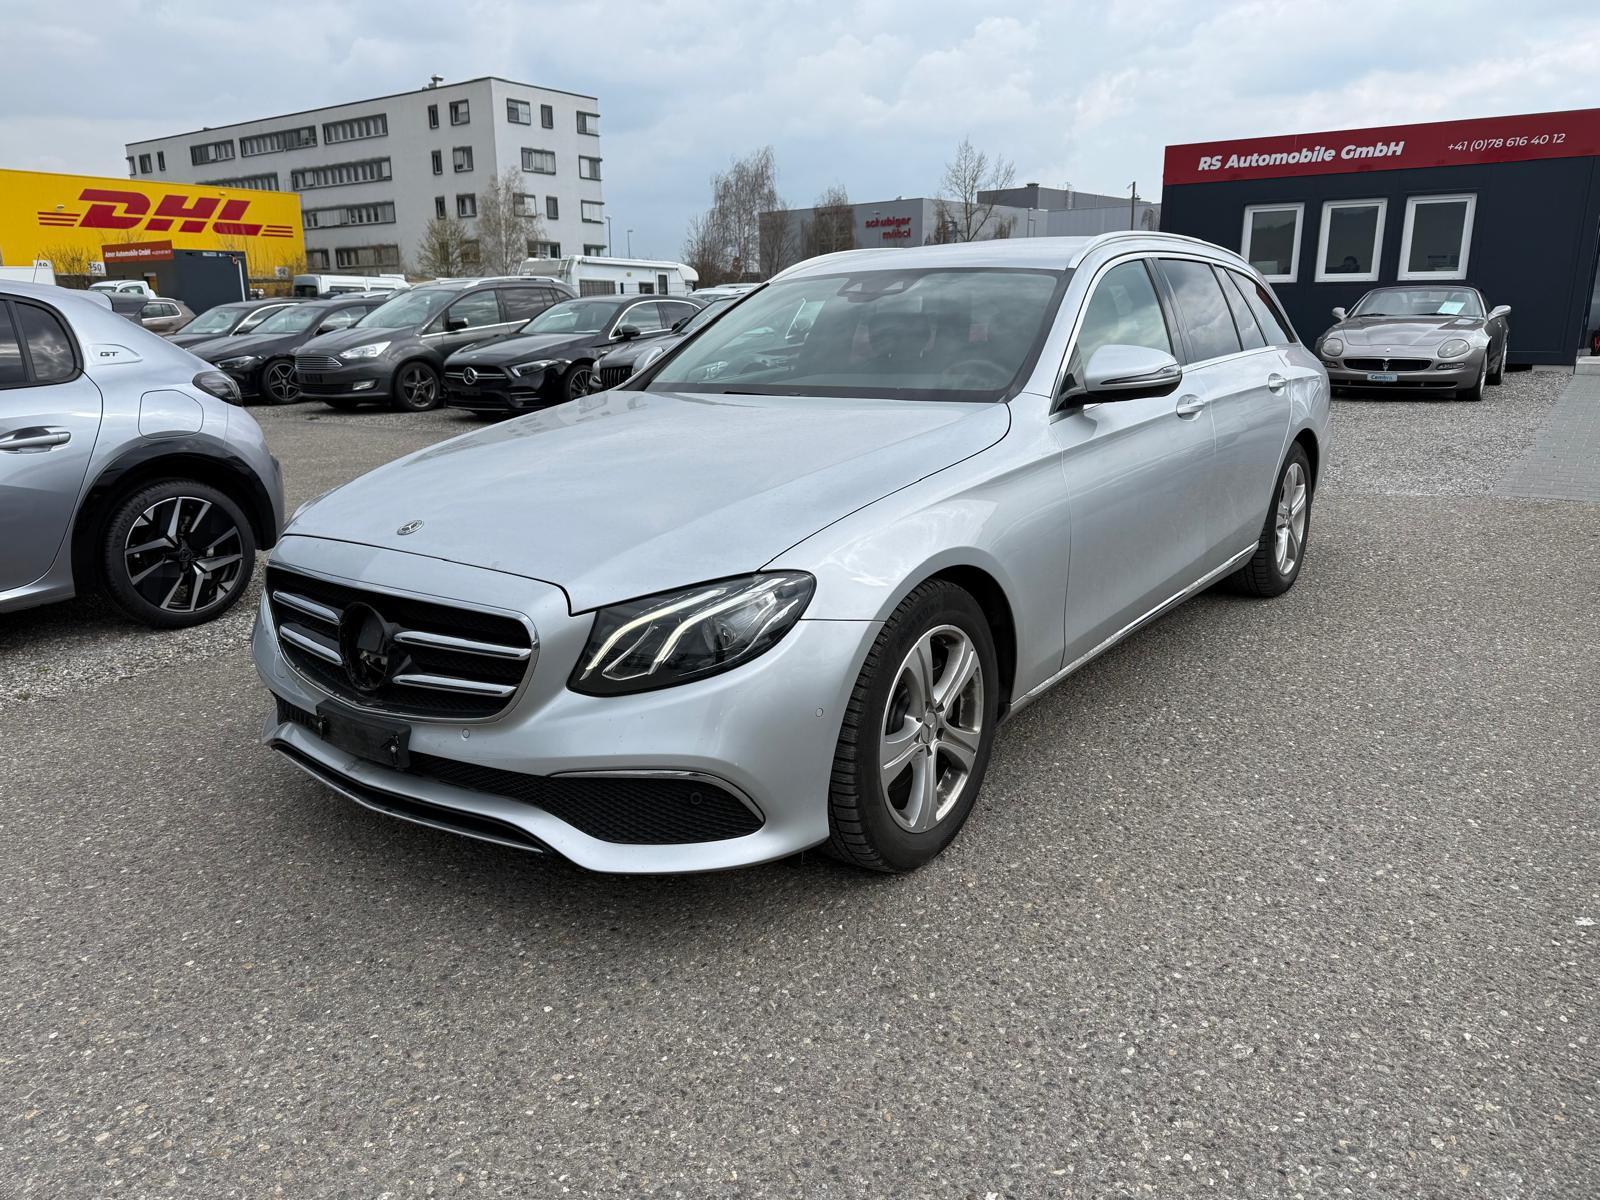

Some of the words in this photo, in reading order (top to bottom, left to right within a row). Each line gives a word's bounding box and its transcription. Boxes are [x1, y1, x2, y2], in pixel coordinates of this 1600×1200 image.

[1447, 141, 1468, 151] +41
[1470, 138, 1504, 152] (0)78
[1506, 136, 1529, 147] 616
[1530, 134, 1550, 145] 40
[1552, 133, 1566, 144] 12
[1198, 155, 1223, 171] RS
[1224, 145, 1336, 169] Automobile
[1340, 141, 1405, 160] GmbH
[78, 188, 264, 237] DHL
[864, 216, 912, 228] schubiger
[116, 248, 138, 257] Automobile
[138, 248, 151, 256] GmbH
